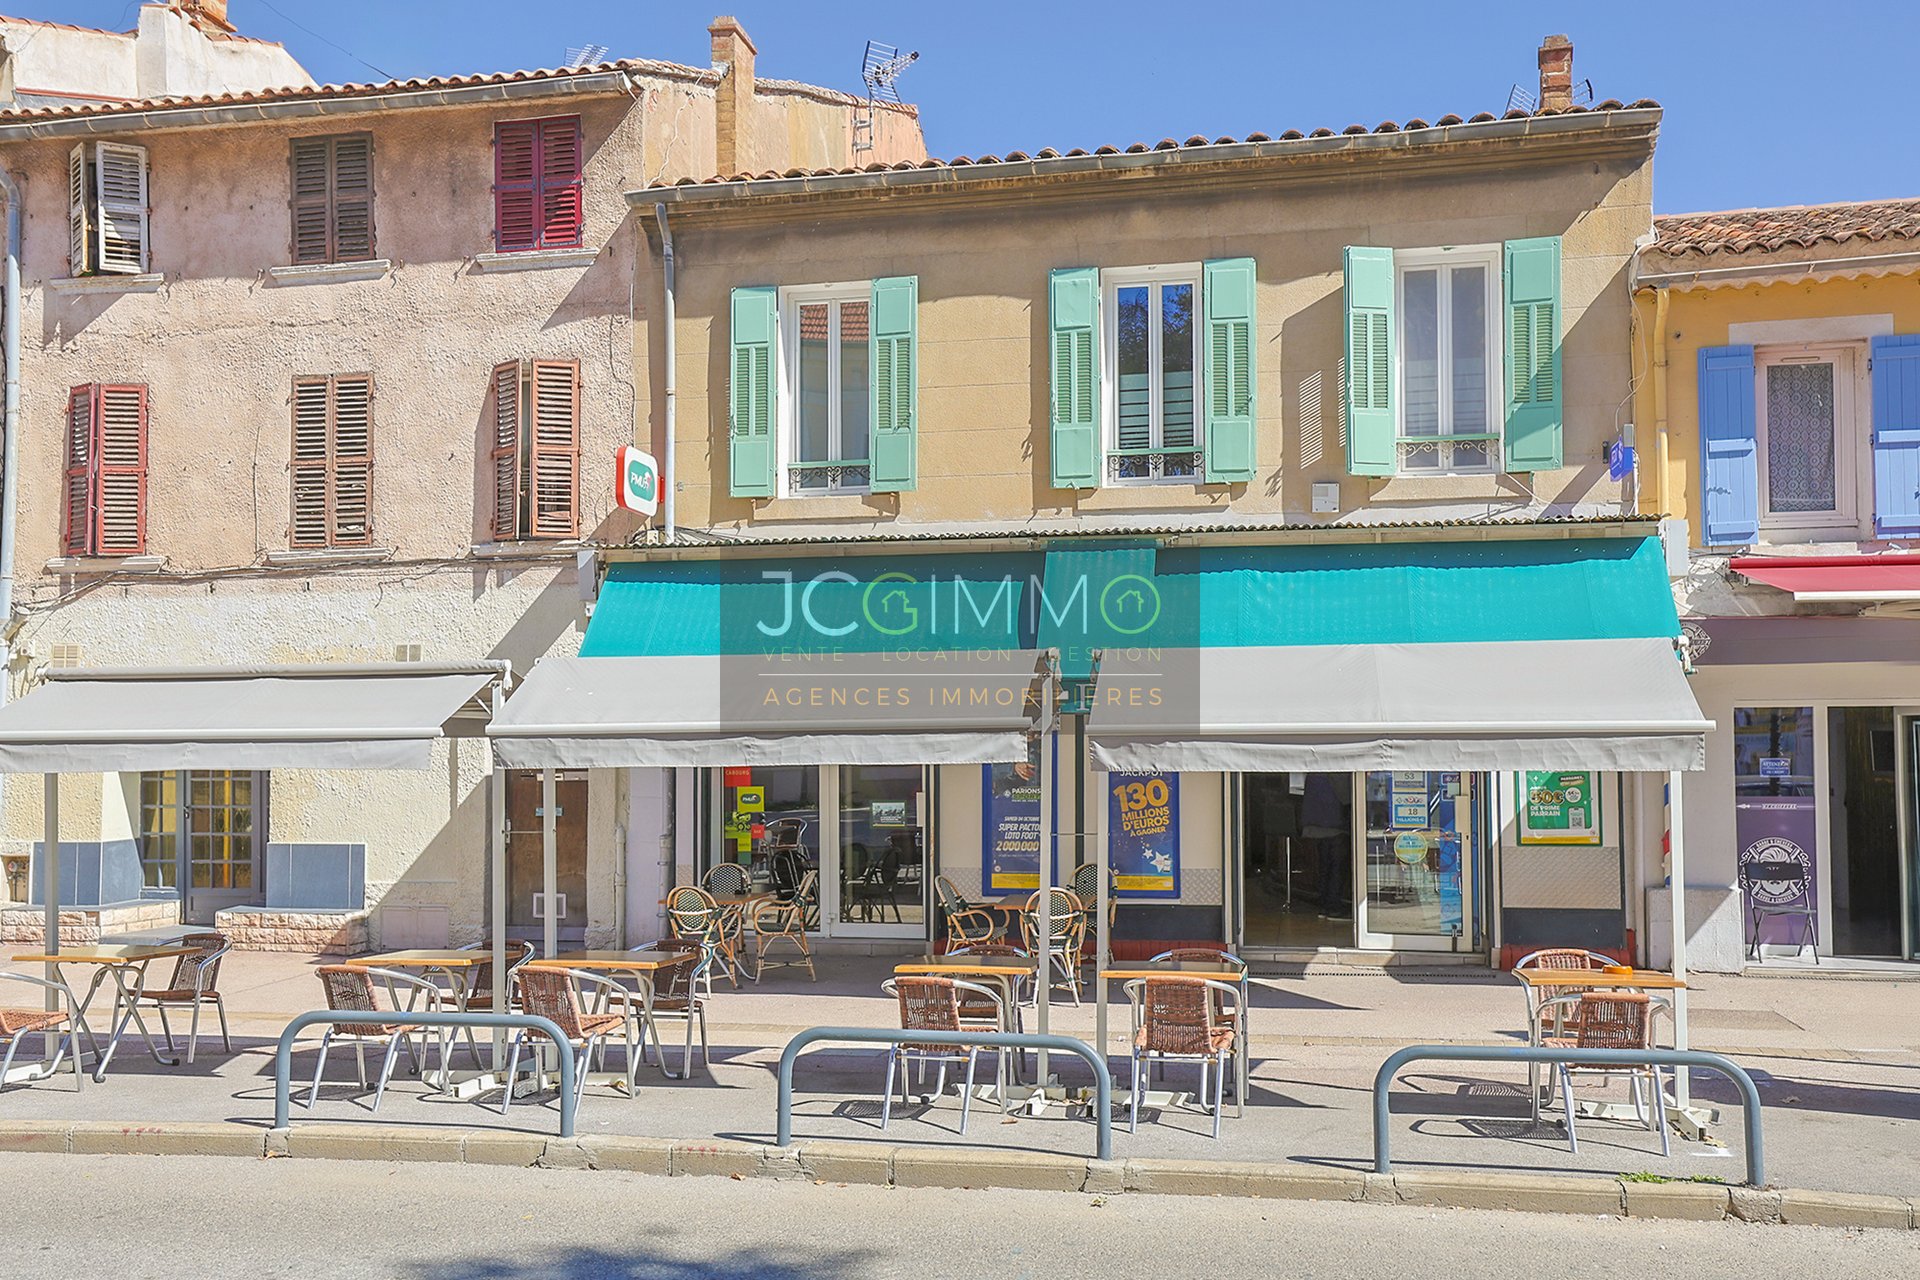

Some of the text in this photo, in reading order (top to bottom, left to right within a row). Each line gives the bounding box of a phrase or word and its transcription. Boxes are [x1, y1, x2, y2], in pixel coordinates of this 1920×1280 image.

[630, 471, 650, 490] PMU
[1404, 772, 1415, 780] 53
[1113, 778, 1169, 812] 130
[1121, 806, 1170, 822] MILLIONS
[1407, 807, 1418, 816] 18
[998, 823, 1041, 831] SUPER PACTO
[1122, 815, 1170, 831] D'EUROS
[1004, 831, 1038, 840] LOTO FOOT
